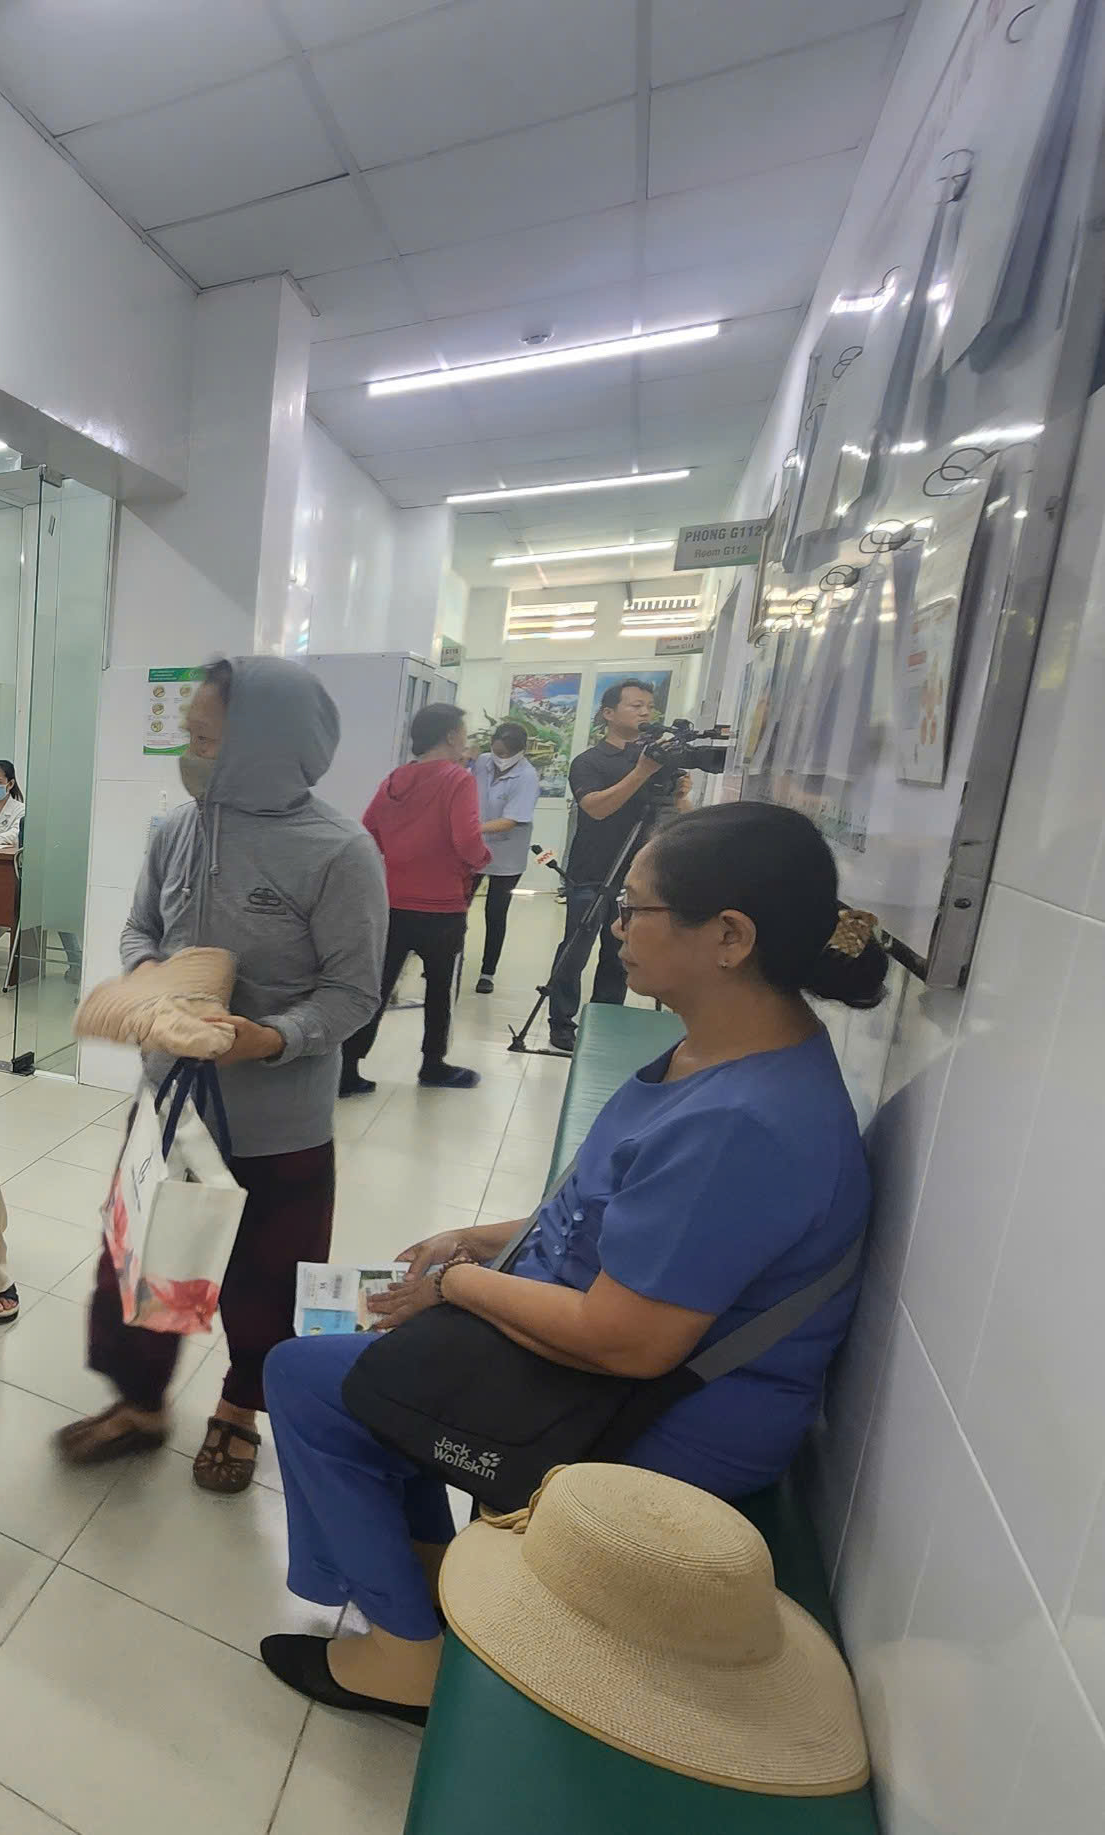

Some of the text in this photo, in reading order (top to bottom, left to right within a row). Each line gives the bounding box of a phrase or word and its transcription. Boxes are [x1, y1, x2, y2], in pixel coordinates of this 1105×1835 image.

[694, 544, 749, 558] Room G112
[435, 1436, 472, 1458] Jack
[434, 1446, 496, 1480] Wolfskin
